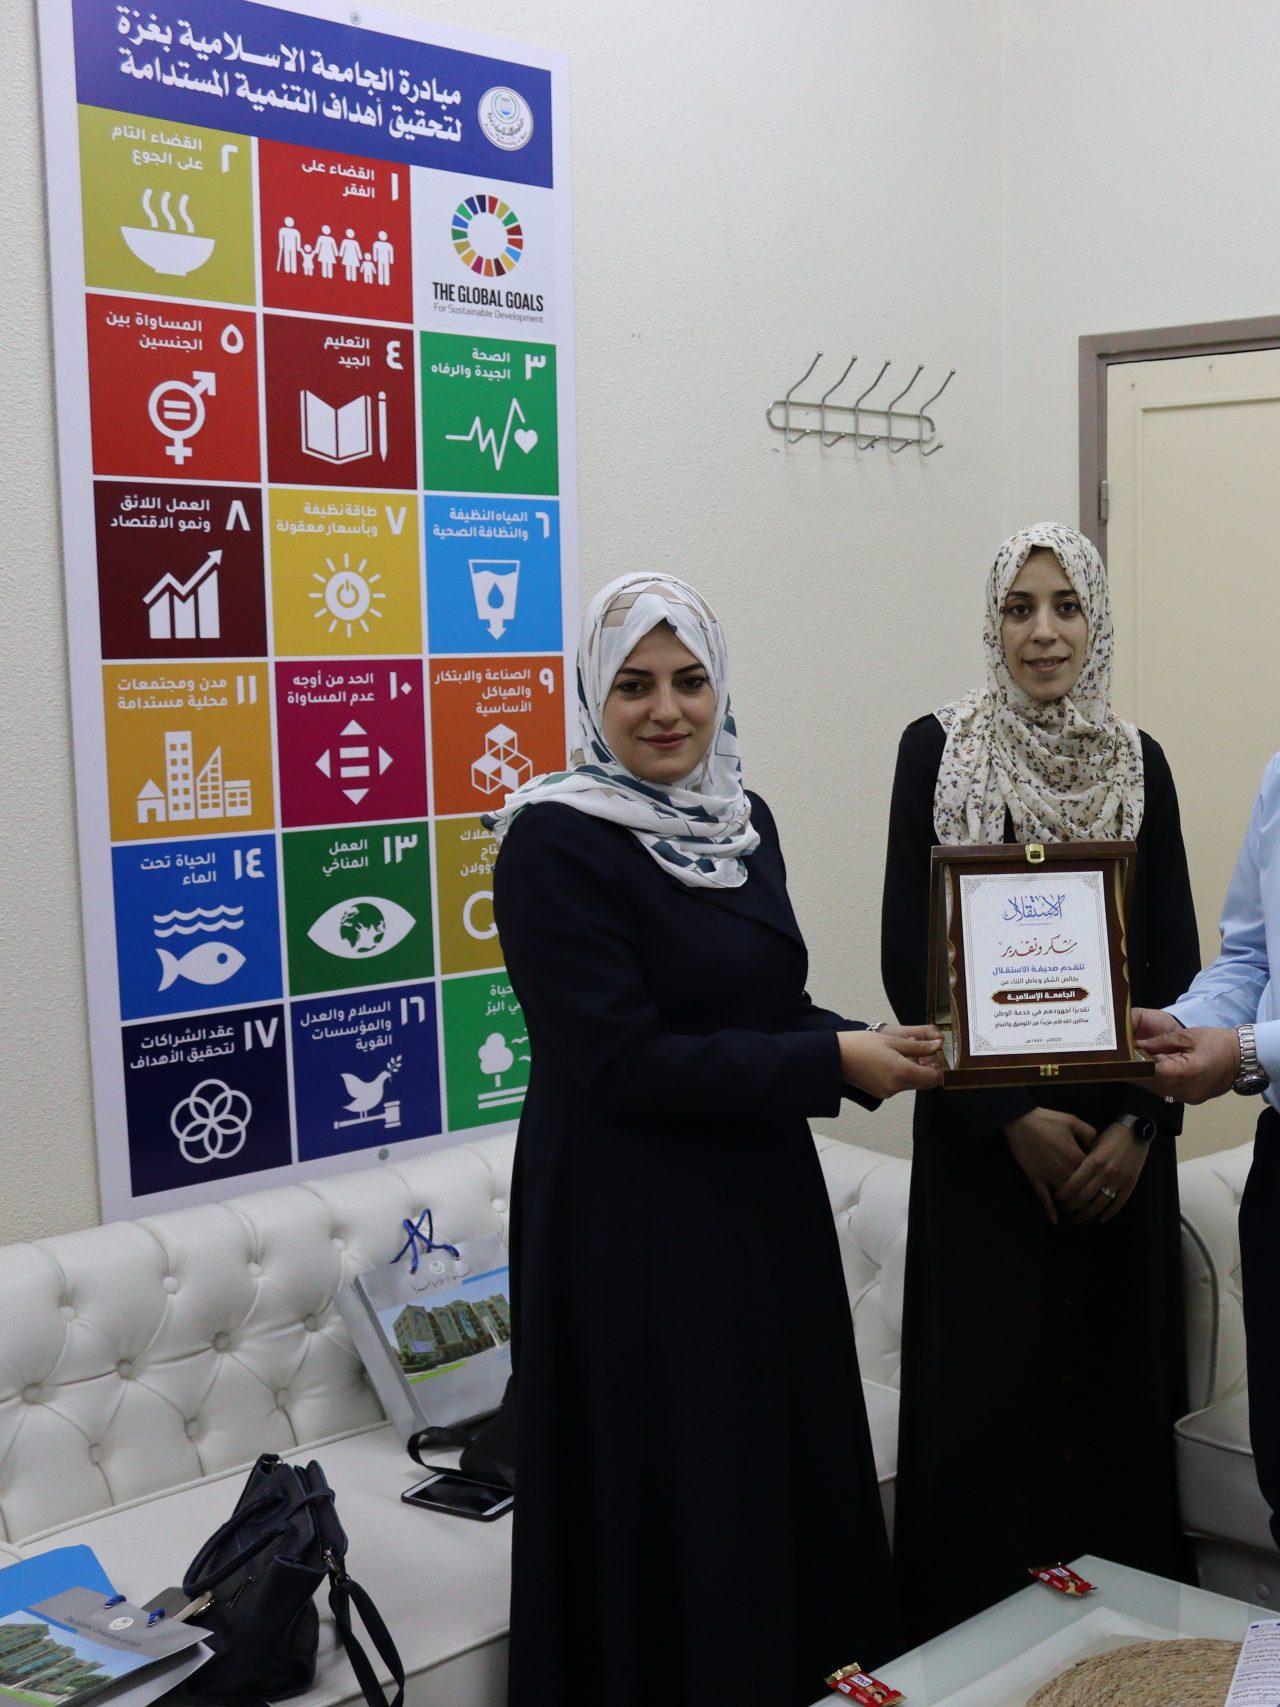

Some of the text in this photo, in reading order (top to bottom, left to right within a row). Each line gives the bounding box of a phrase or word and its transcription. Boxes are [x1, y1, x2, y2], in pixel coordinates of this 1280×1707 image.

[116, 5, 462, 111] مبادرة الجامعة الاسلامية بغزة
[119, 47, 230, 98] المستدامة
[234, 72, 318, 114] التنمية
[322, 91, 383, 127] أهداف
[389, 102, 463, 142] لتحقيق
[112, 124, 203, 151] القضاء التام
[131, 149, 203, 170] على الجوع
[221, 144, 238, 173] ٢
[301, 159, 375, 181] القضاء على
[342, 184, 375, 198] الفقر
[391, 172, 399, 201] ١
[432, 282, 544, 312] THE GLOBAL GOALS
[106, 311, 202, 332] المساواة بين
[434, 302, 543, 324] For Sustainable Development
[139, 335, 203, 353] الجنسين
[220, 323, 244, 354] ٥
[323, 336, 370, 350] التعليم
[338, 356, 371, 370] الجيد
[386, 340, 404, 370] ٤
[472, 347, 511, 363] الصحة
[431, 364, 511, 381] الجيدة والرفاه
[525, 354, 546, 380] ٣
[120, 494, 210, 512] العمل اللائق
[303, 502, 377, 518] طاقة نظيفة
[110, 515, 211, 532] ونمو الاقتصاد
[225, 500, 251, 531] ٨
[385, 506, 407, 535] ٧
[449, 508, 528, 522] المياه النظيفة
[535, 512, 550, 539] ٦
[276, 519, 378, 538] وبأسعار معقولة
[433, 524, 528, 541] والنظافة الصحية
[117, 677, 227, 692] مدن ومجتمعات
[292, 670, 374, 688] الحد من أوجه
[389, 671, 413, 700] ١٠
[434, 669, 531, 684] الصناعة والابتكار
[539, 668, 554, 695] ٩
[117, 695, 229, 710] محلية مستدامة
[287, 691, 375, 706] عدم المساواة
[481, 686, 531, 700] والهياكل
[475, 701, 532, 717] الأساسية
[328, 840, 368, 856] العمل
[383, 834, 418, 864] ١٣
[140, 853, 216, 871] الحياة تحت
[233, 848, 265, 880] ١٤
[322, 857, 369, 877] المناخي
[182, 871, 217, 886] الماء
[998, 934, 1078, 958] شكر وتقدير
[992, 963, 1086, 975] تتقدم صحيفة الاستقلال
[1043, 976, 1059, 984] الشكر
[490, 984, 514, 998] حياة
[1007, 991, 1075, 1001] الجامعة الإسلامية
[300, 1001, 391, 1027] السلام والعدل
[400, 996, 426, 1026] ١٦
[141, 1025, 234, 1049] عقد الشراكات
[244, 1017, 279, 1051] ١٧
[312, 1019, 392, 1040] والمؤسسات
[356, 1035, 392, 1052] القوية
[130, 1043, 235, 1070] لتحقيق الأهداف
